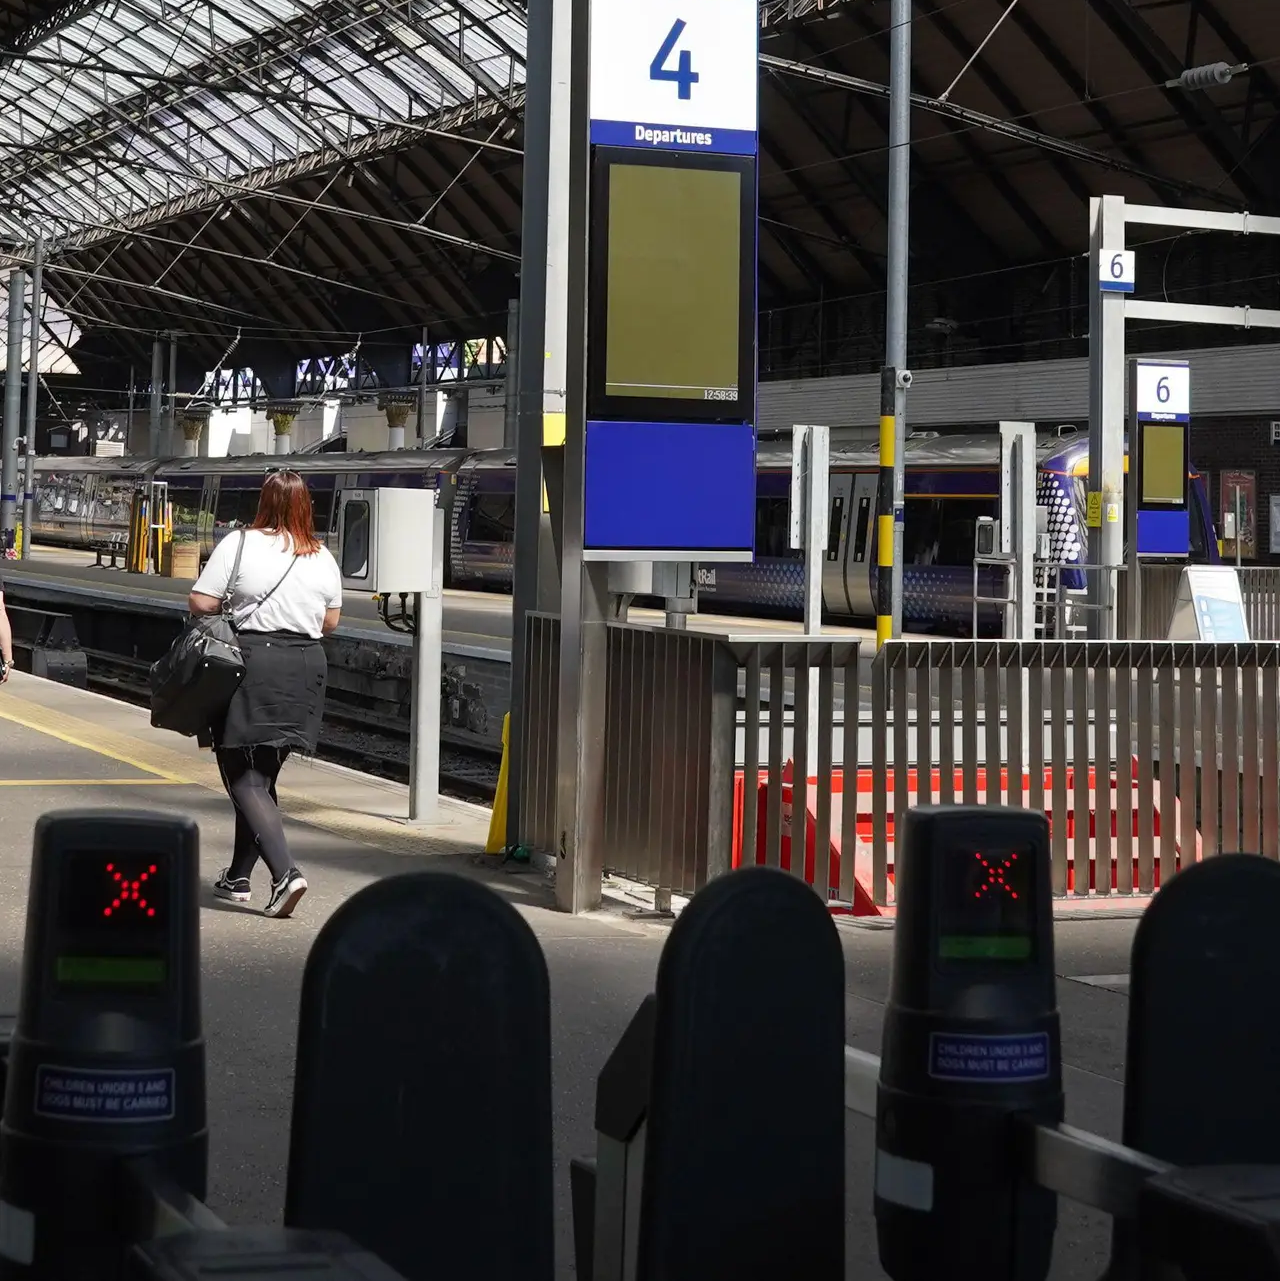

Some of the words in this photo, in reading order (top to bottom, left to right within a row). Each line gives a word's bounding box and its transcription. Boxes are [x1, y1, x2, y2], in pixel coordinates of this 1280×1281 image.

[650, 19, 699, 99] 4
[635, 126, 712, 146] Departures
[1110, 252, 1124, 279] 6
[704, 390, 738, 401] 12:58:39
[1157, 376, 1170, 403] 6
[937, 1042, 988, 1056] CHILDREN
[989, 1044, 1021, 1057] UNDER
[937, 1057, 965, 1070] DOGS
[967, 1059, 995, 1072] MUST
[996, 1060, 1009, 1071] BE
[43, 1076, 96, 1094] CHILDREN
[97, 1081, 135, 1095] UNDER
[145, 1079, 167, 1094] AND
[72, 1095, 103, 1111] MUST
[104, 1097, 120, 1111] BE
[122, 1095, 168, 1111] CARRIED
